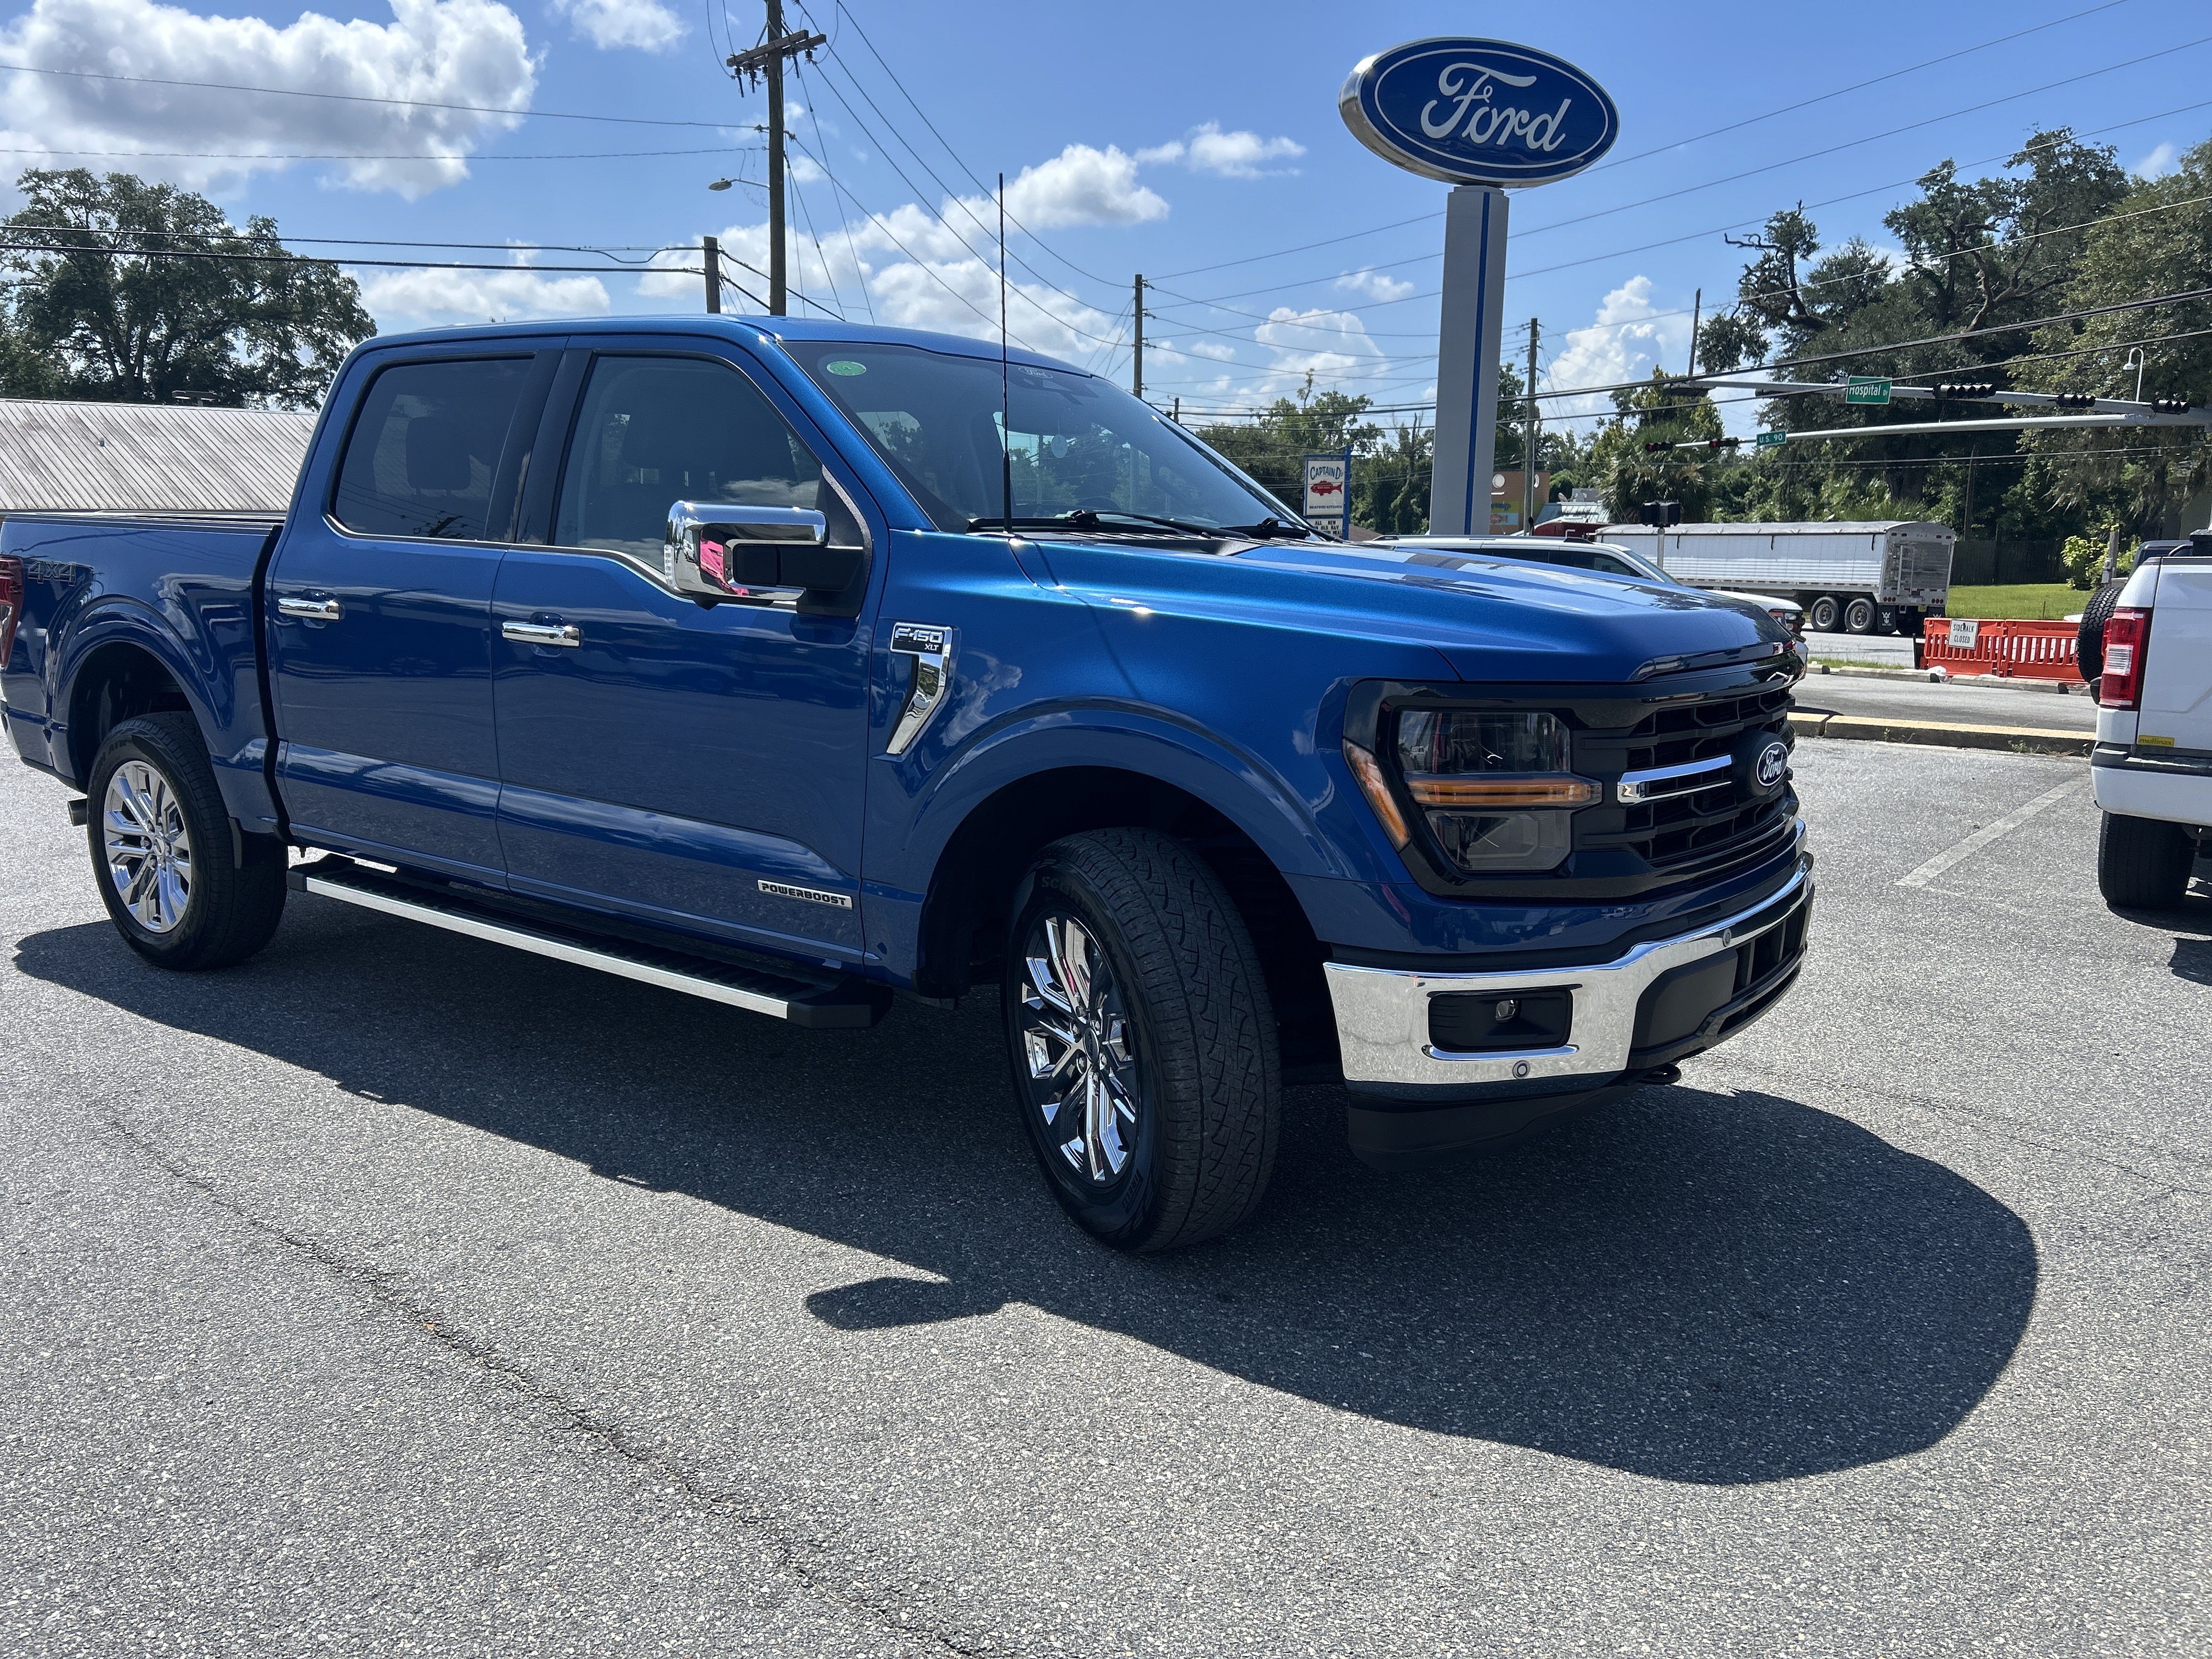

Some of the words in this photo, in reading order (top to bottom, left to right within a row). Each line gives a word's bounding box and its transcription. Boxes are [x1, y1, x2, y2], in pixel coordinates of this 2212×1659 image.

[1421, 62, 1571, 151] Ford
[1024, 368, 1048, 378] Ford
[1849, 384, 1881, 398] Hospital
[894, 627, 944, 644] F-150
[1954, 635, 1970, 644] CLOSED
[924, 643, 939, 651] XLT
[1763, 748, 1784, 781] Ford
[761, 883, 846, 905] POWERBOOST
